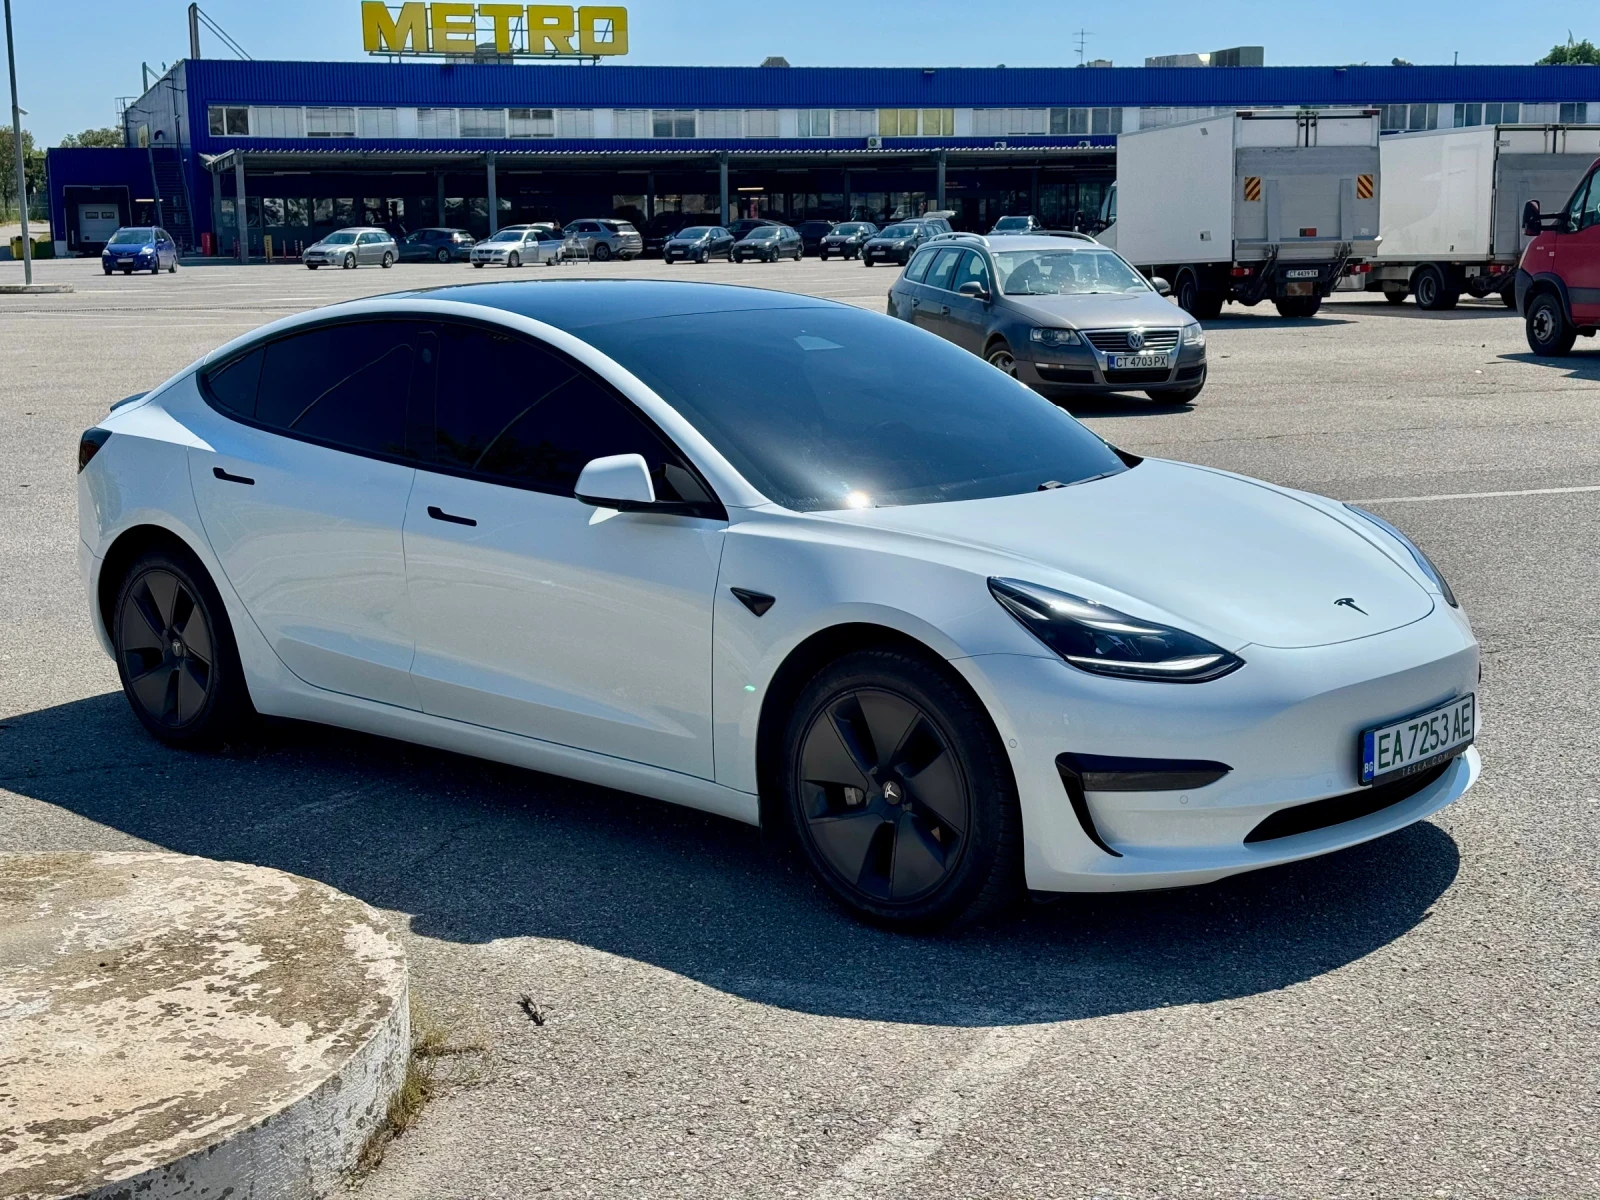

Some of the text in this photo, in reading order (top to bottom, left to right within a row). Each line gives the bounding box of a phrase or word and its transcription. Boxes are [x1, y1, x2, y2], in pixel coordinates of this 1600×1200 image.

[361, 1, 628, 55] METRO
[1116, 355, 1166, 368] CT 4703 PX
[1378, 702, 1471, 770] EA 7253 AE
[1364, 761, 1374, 774] BG
[1402, 752, 1450, 776] TESLA.COM
